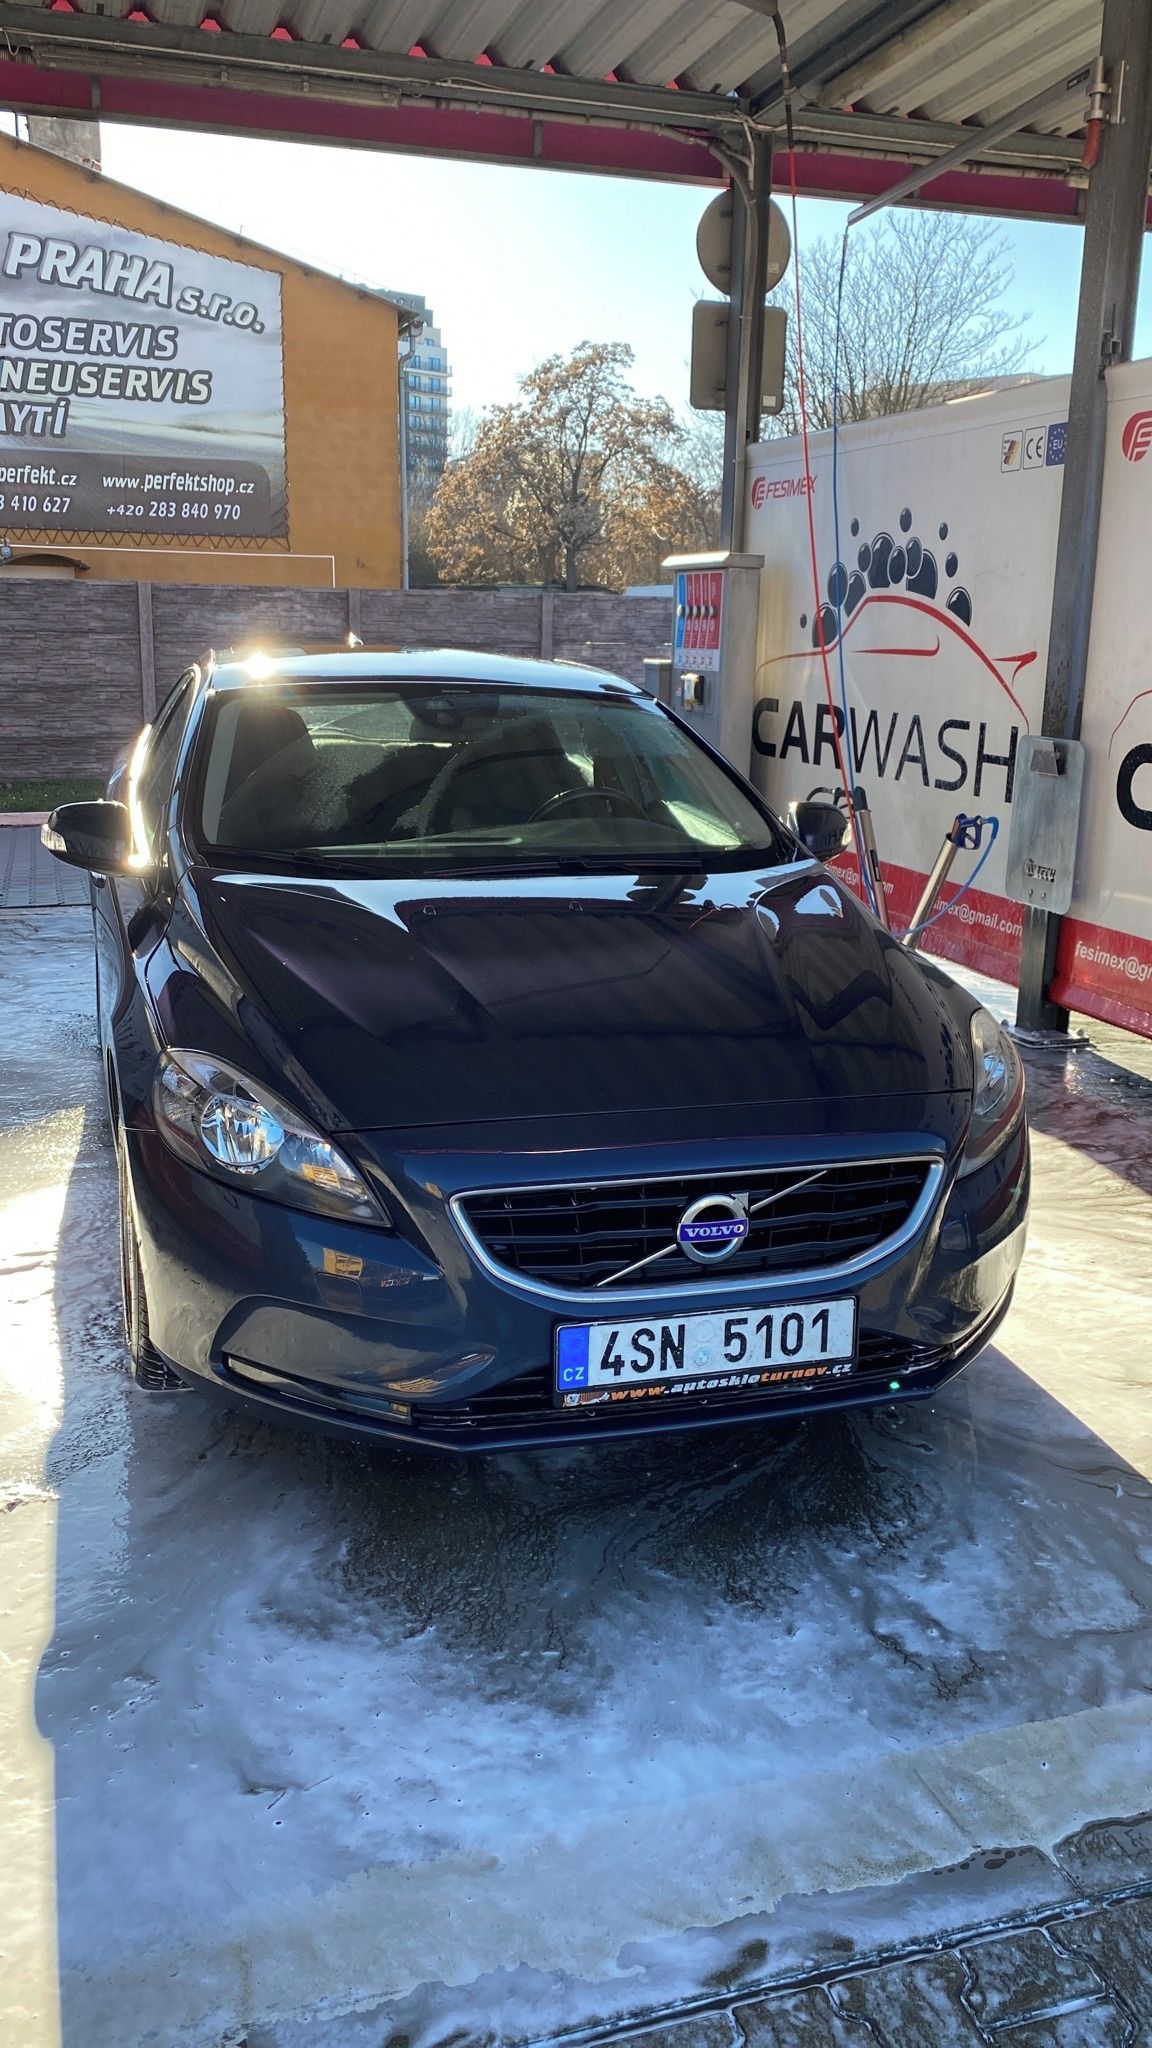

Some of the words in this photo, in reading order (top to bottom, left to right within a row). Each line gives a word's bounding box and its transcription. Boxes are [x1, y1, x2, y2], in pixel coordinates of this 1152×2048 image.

[4, 233, 174, 307] PRAHA
[179, 286, 265, 333] s.r.o.
[1052, 439, 1064, 450] EU
[102, 472, 255, 496] www.perfektshop.cz
[765, 475, 818, 500] FESIMEX
[11, 495, 37, 512] 410
[42, 497, 71, 513] 627
[106, 504, 144, 517] +420
[149, 502, 176, 518] 283
[181, 503, 208, 519] 840
[214, 504, 241, 520] 970
[752, 697, 1019, 803] CARWASH
[684, 1224, 745, 1238] VOLVO
[600, 1323, 686, 1376] 4SN
[723, 1308, 830, 1364] 5101
[563, 1366, 585, 1382] CZ
[610, 1362, 853, 1400] www.autoskloturnov.cz
